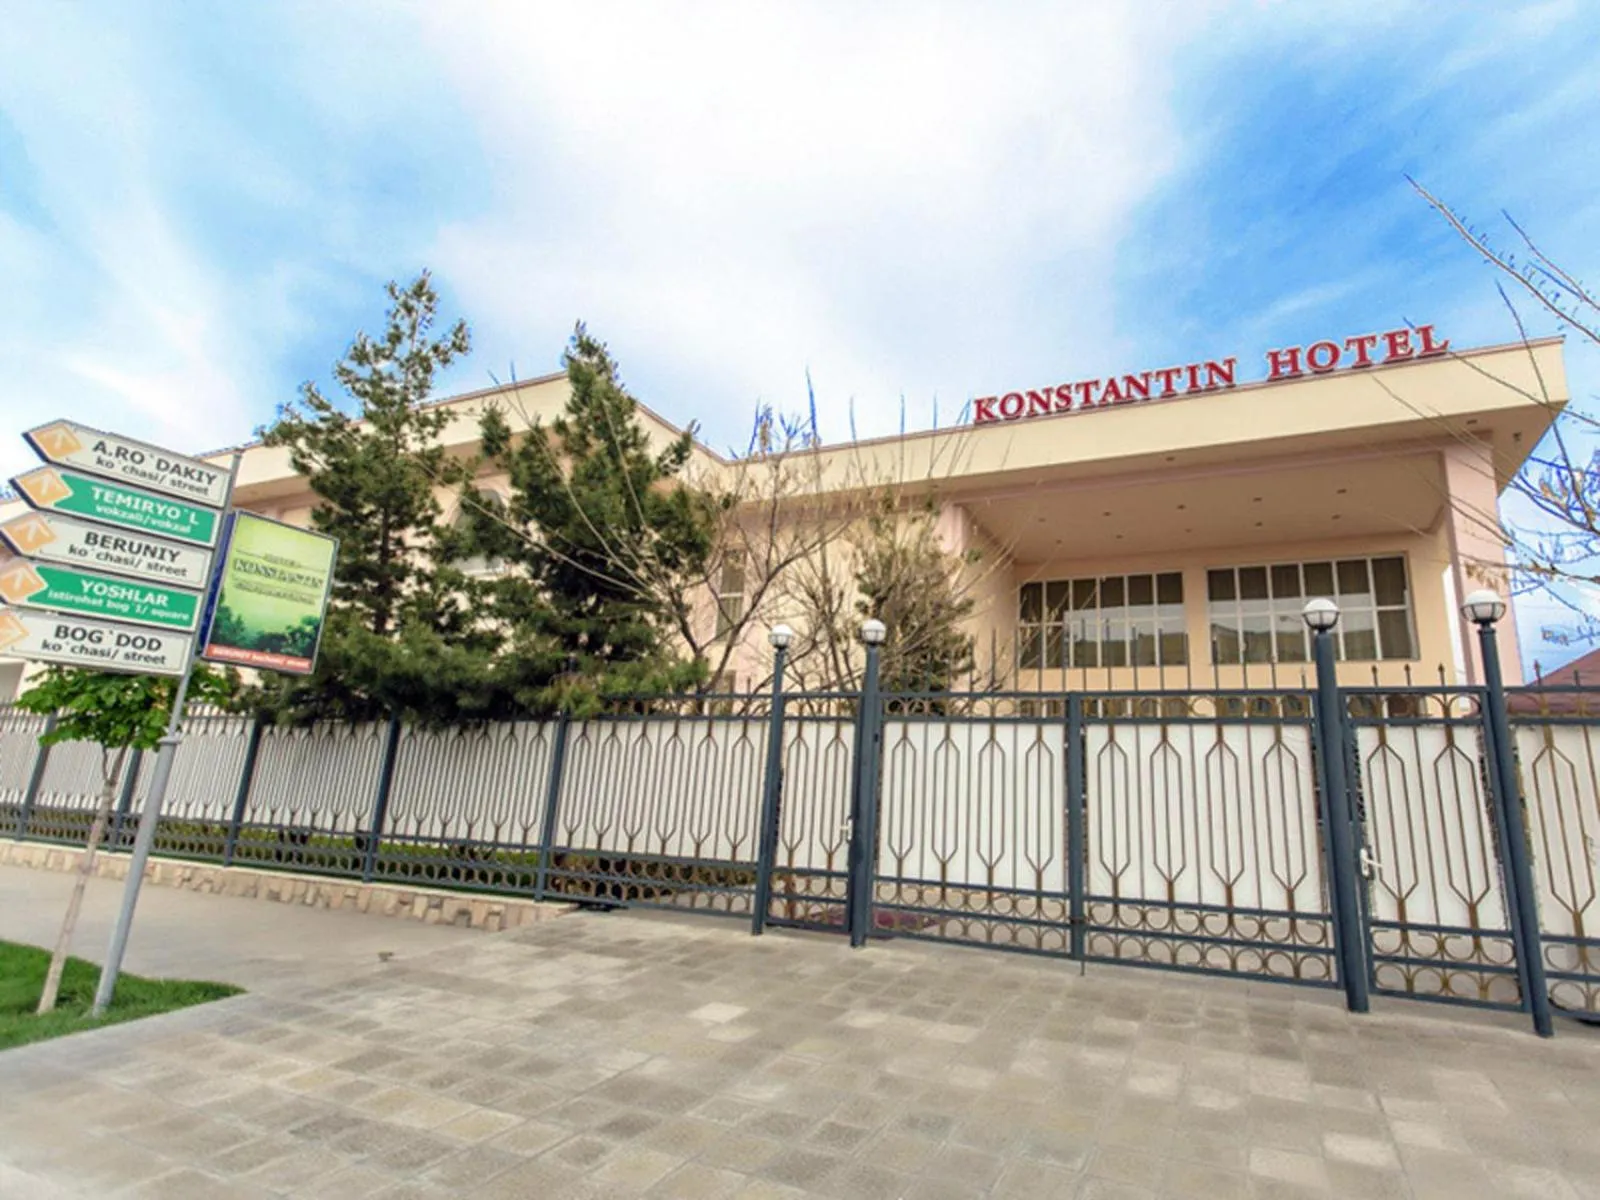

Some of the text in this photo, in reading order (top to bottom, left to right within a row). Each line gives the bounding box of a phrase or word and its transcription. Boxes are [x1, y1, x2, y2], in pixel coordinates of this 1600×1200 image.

[974, 324, 1450, 423] KONSTANTIN HOTEL
[169, 477, 209, 495] street
[84, 531, 181, 563] BERUNIY
[147, 560, 188, 577] street
[80, 579, 169, 606] YOSHLAR
[124, 651, 167, 665] street
